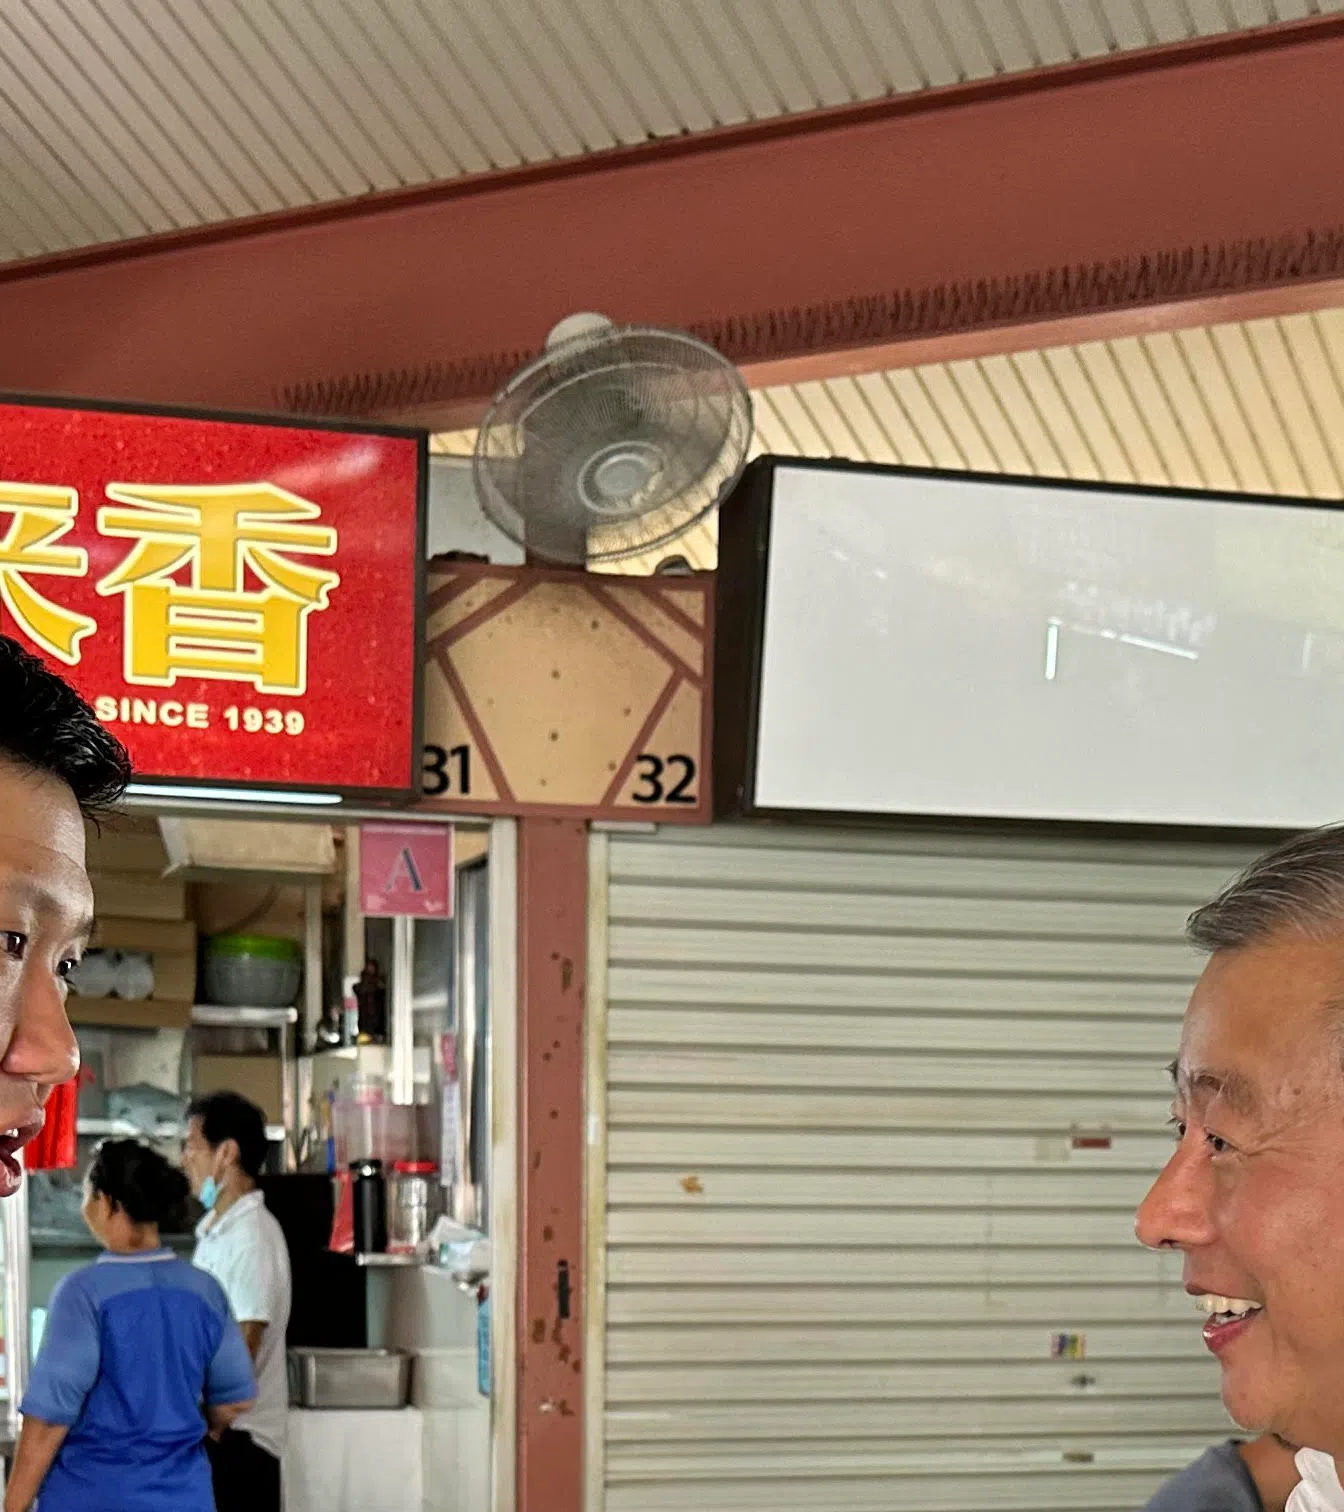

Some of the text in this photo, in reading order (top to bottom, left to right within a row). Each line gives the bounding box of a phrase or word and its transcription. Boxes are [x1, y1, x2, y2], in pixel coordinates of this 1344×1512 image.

[94, 694, 211, 730] SINCE
[223, 705, 306, 737] 1939
[422, 744, 471, 796] 31
[631, 753, 698, 804] 32
[384, 846, 424, 893] A
